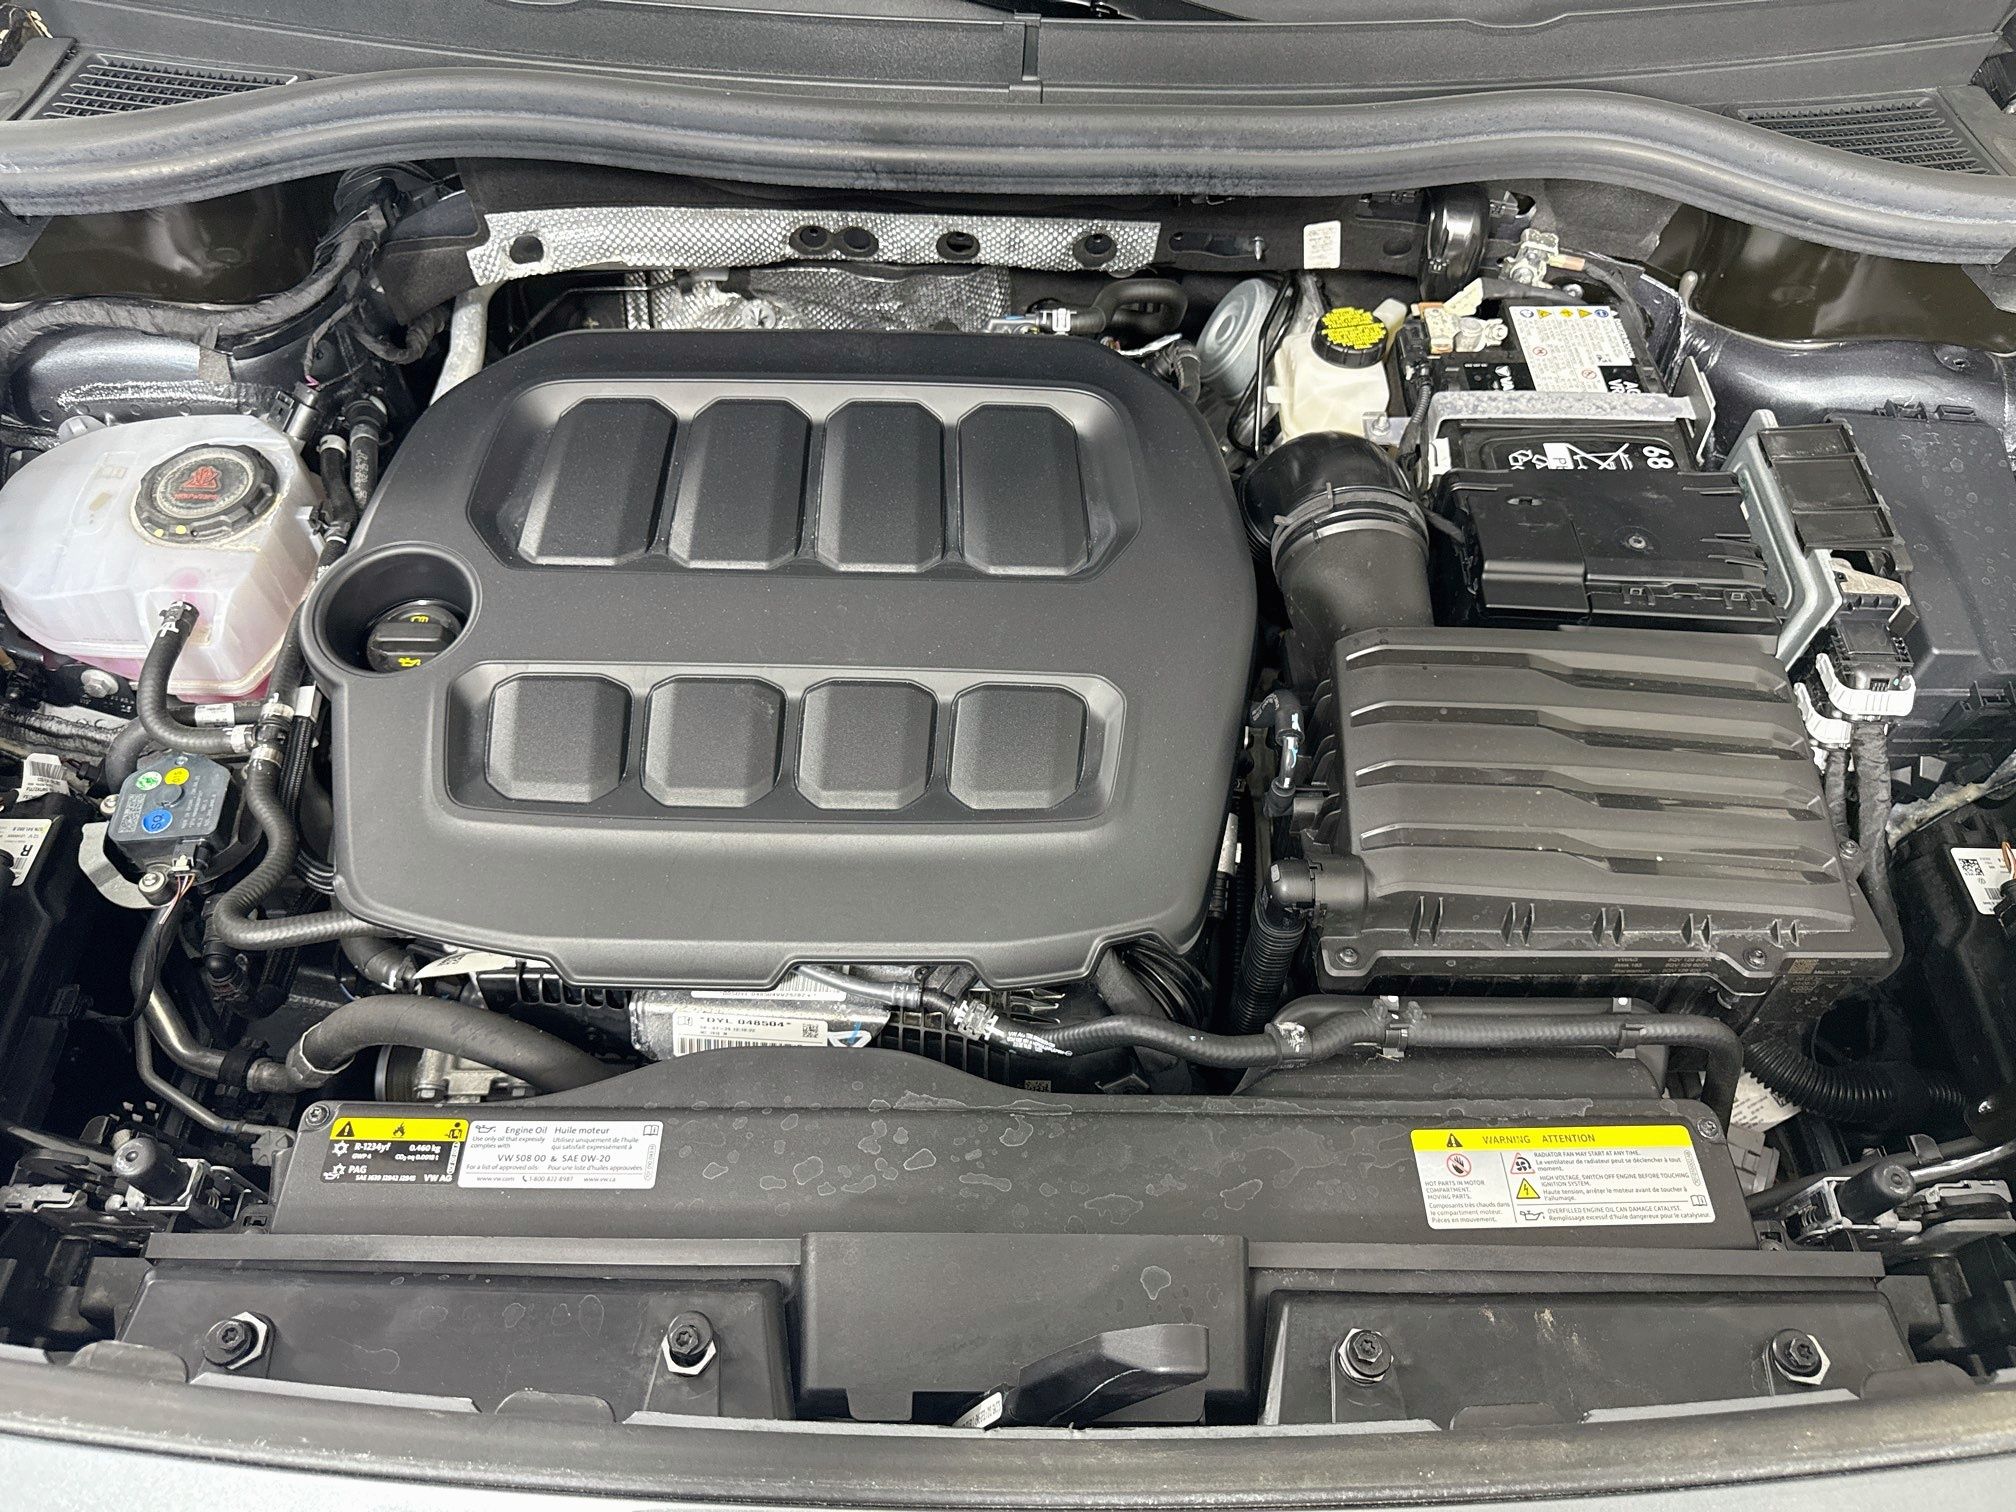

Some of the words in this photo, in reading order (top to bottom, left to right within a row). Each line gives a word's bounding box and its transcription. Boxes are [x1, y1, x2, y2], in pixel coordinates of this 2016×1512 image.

[1642, 446, 1674, 469] 68
[20, 844, 34, 856] R
[505, 1127, 533, 1135] Engine
[1483, 1135, 1530, 1144] WARNING
[1542, 1134, 1596, 1143] ATTENTION
[354, 1142, 392, 1153] R-1234yf
[432, 1144, 441, 1154] kg
[348, 1165, 367, 1173] PAG
